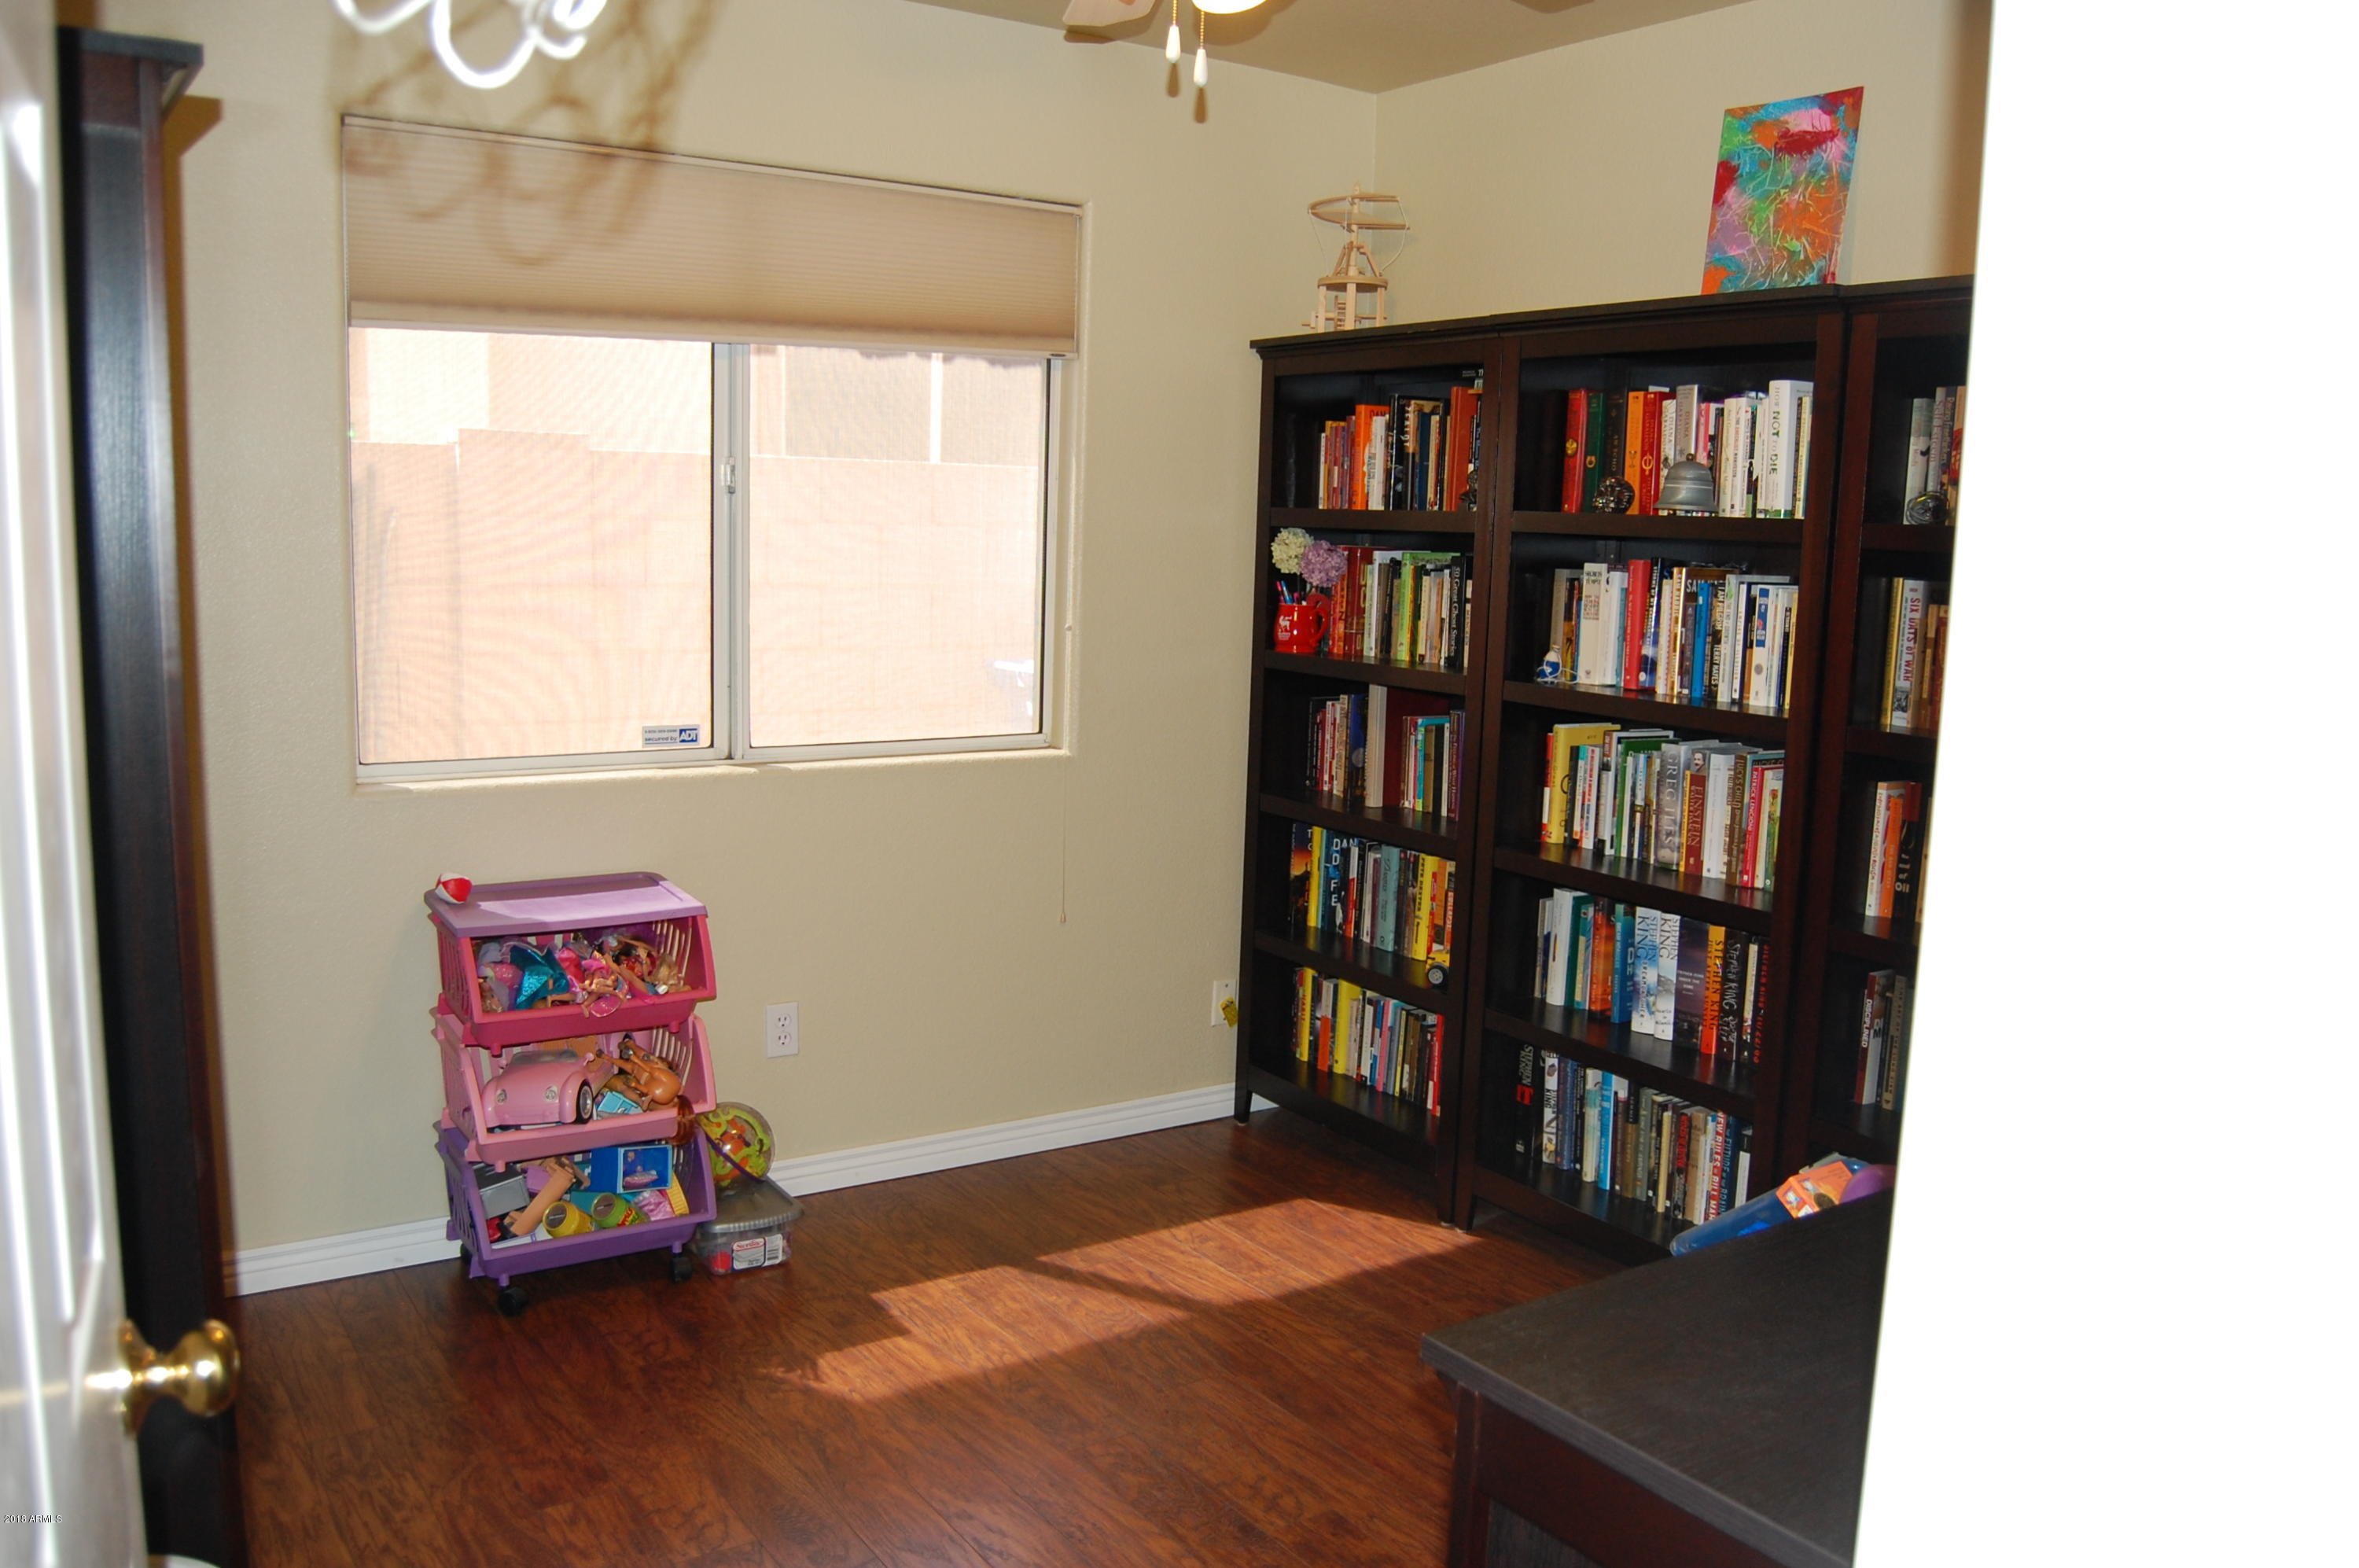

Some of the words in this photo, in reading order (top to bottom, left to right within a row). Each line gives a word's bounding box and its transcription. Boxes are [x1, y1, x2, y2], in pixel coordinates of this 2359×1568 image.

[1400, 407, 1411, 447] ZEALOT
[1772, 410, 1780, 437] NOT
[1772, 440, 1777, 451] TO
[1769, 454, 1778, 475] DIE
[1453, 566, 1460, 578] 50
[1717, 590, 1724, 601] AM
[1910, 598, 1920, 613] SIX
[1714, 602, 1724, 630] PILGRIM
[1908, 618, 1918, 642] DAYS
[1711, 665, 1720, 685] HAYES
[679, 731, 698, 740] ADT
[1665, 752, 1678, 801] GREG
[1750, 771, 1758, 797] PATRICK
[1729, 786, 1743, 808] CHILD
[1663, 808, 1676, 844] ILES
[1691, 786, 1703, 846] EINSTEIN
[1747, 799, 1756, 832] LENCIONI
[1636, 915, 1649, 959] KING
[1647, 916, 1658, 963] STEPHEN
[1658, 918, 1671, 959] KING
[1670, 918, 1679, 960] STEPHEN
[1712, 940, 1724, 994] STEPHEN
[1726, 940, 1741, 979] STEPHEN
[1723, 981, 1739, 1010] KING
[1708, 1000, 1720, 1031] KING
[1861, 999, 1872, 1047] DISCIPLINED
[1522, 1044, 1533, 1086] STEPHEN
[1545, 1088, 1554, 1108] KING
[1716, 1111, 1724, 1133] NEW
[1713, 1134, 1722, 1167] RULES
[1723, 1138, 1732, 1172] FUTURE
